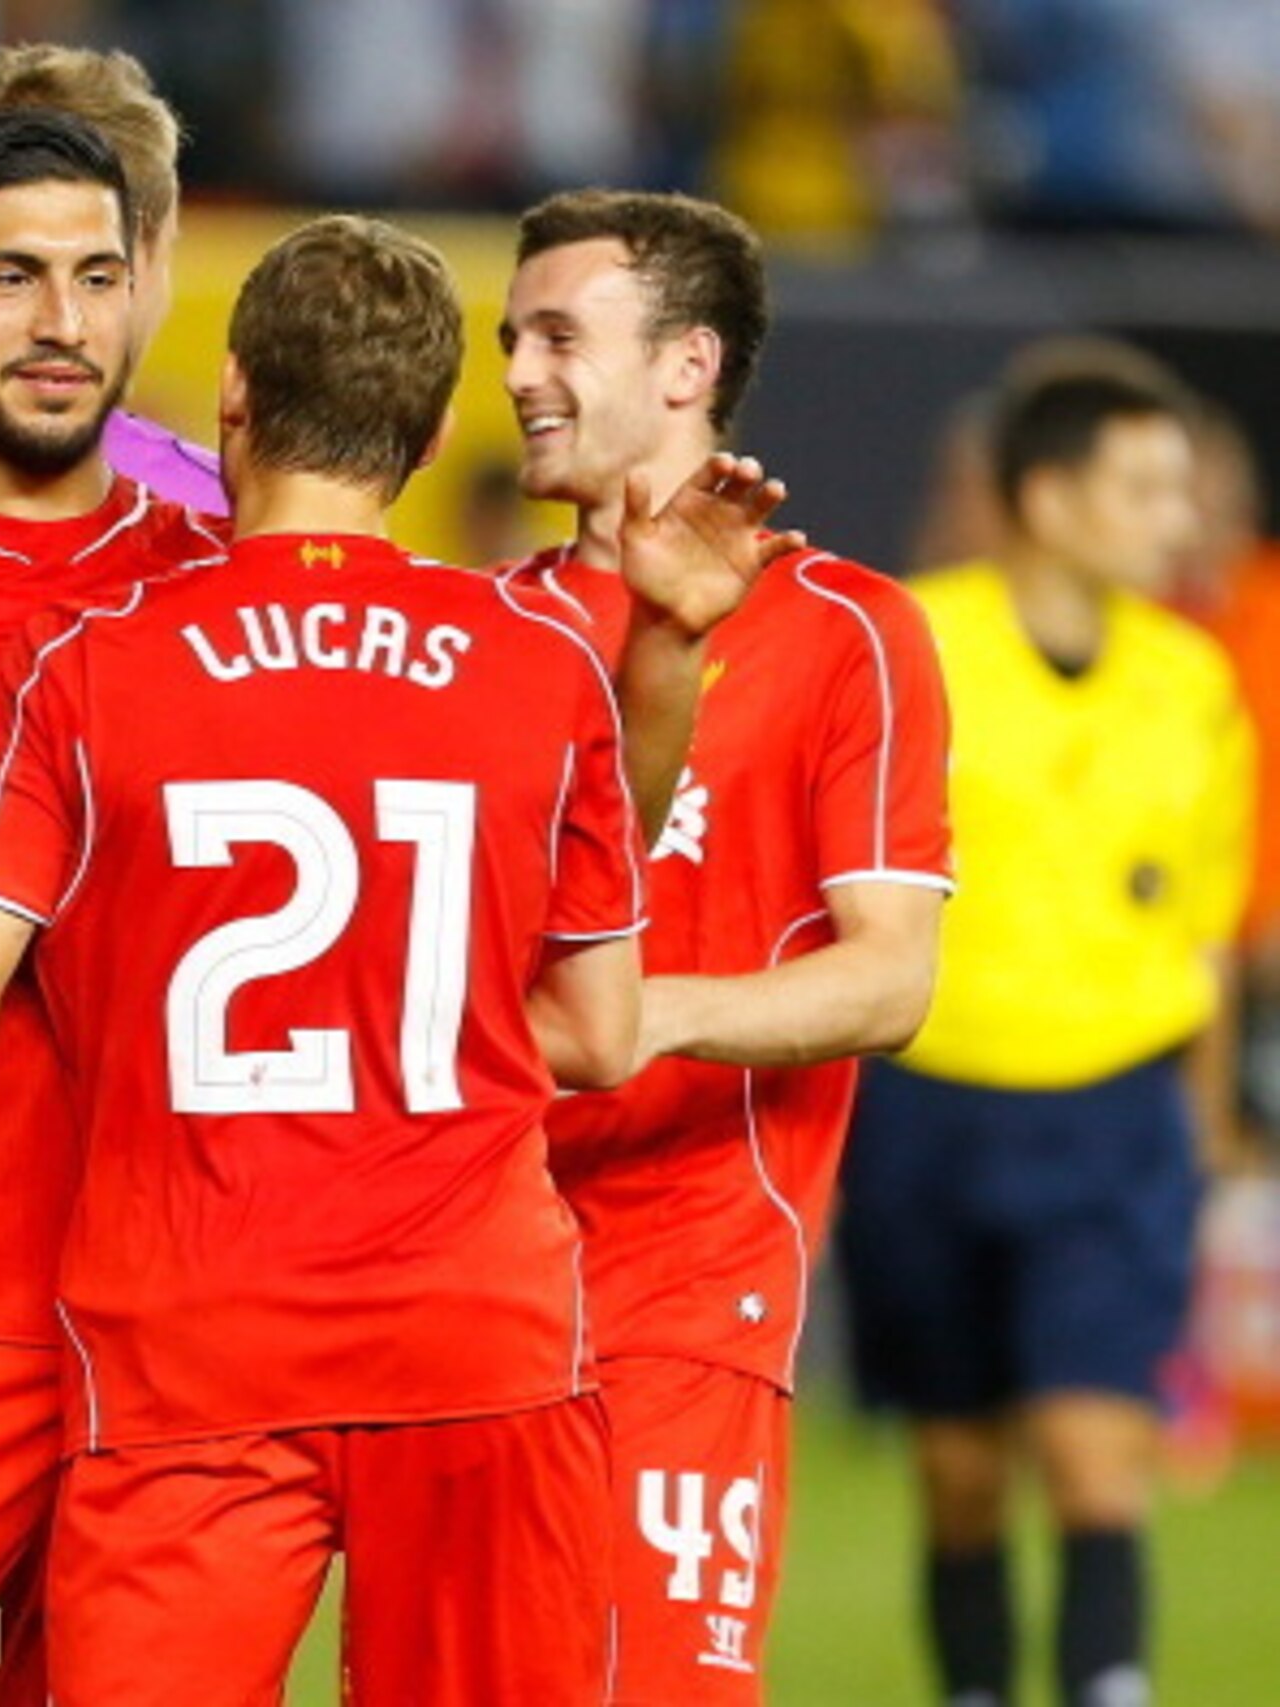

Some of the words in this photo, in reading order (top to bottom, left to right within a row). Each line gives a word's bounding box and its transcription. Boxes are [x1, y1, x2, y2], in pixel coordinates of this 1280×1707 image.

[181, 603, 472, 688] LUCAS
[162, 779, 477, 1115] 21
[637, 1468, 760, 1609] 49
